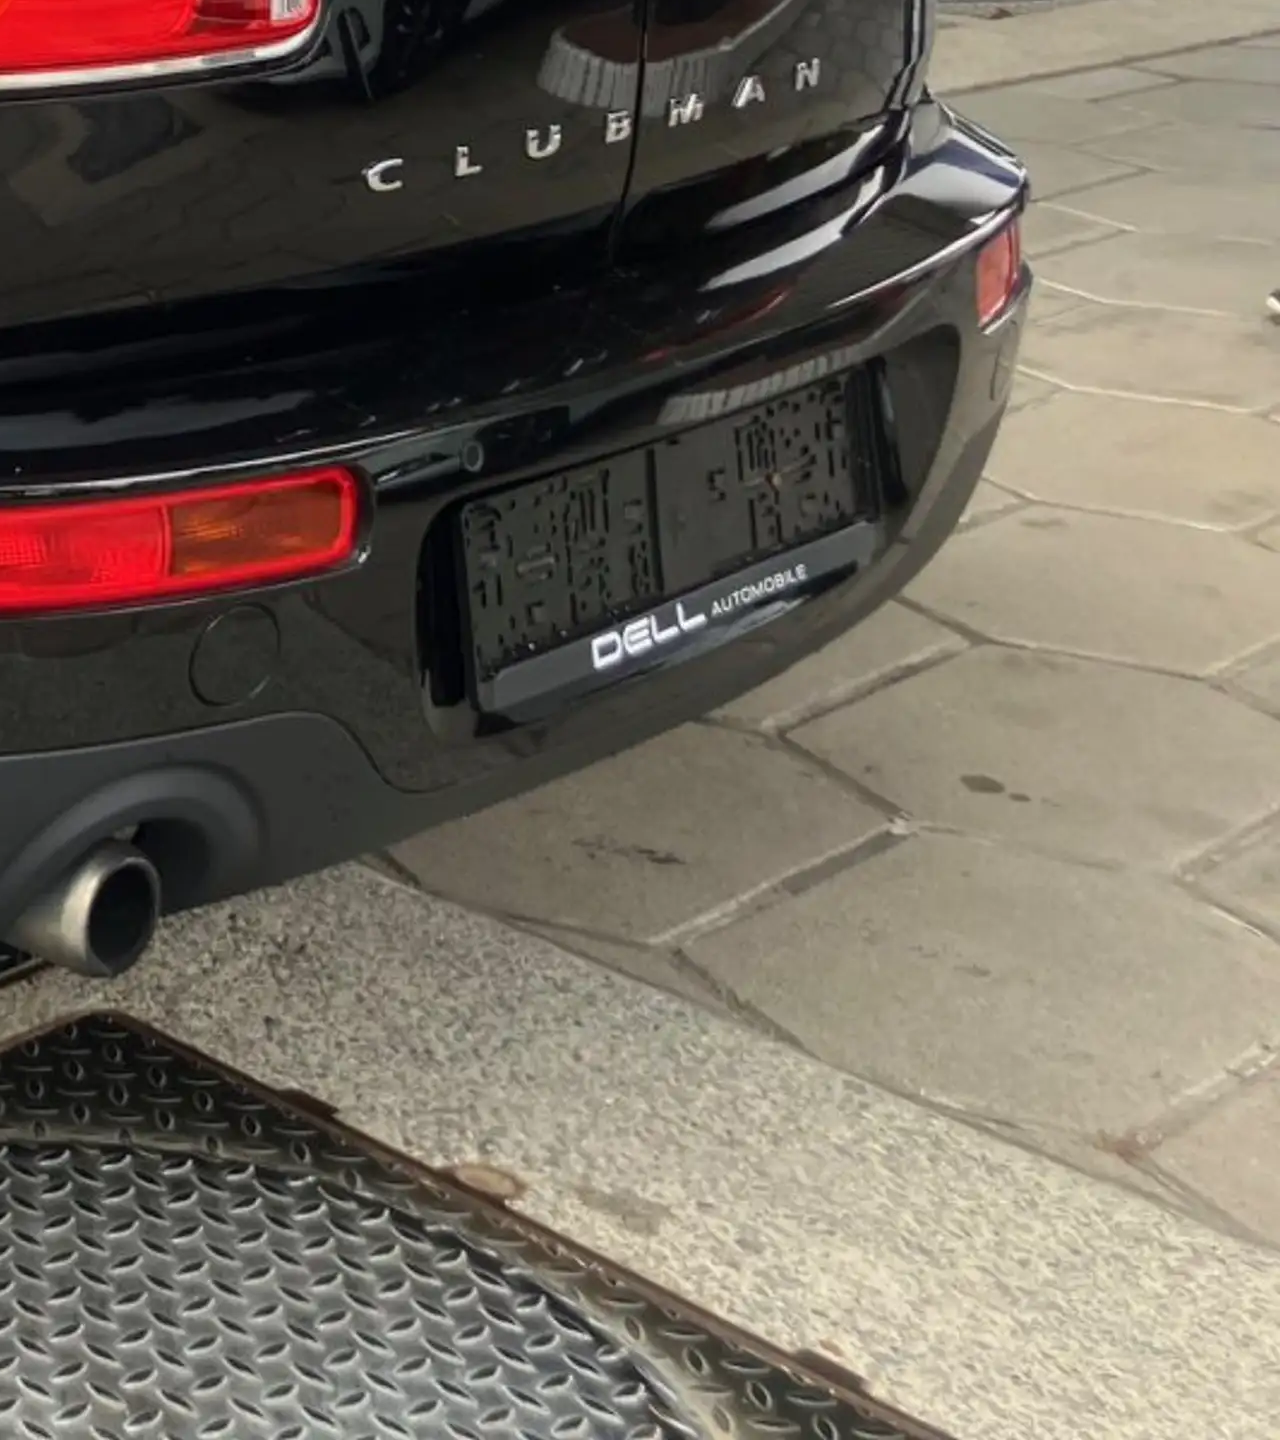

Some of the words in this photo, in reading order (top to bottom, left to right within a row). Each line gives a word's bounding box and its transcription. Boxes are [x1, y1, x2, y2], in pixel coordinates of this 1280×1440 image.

[362, 57, 821, 193] CLUBMAN
[591, 602, 708, 671] DELL
[710, 563, 808, 618] AUTOMOBILE
